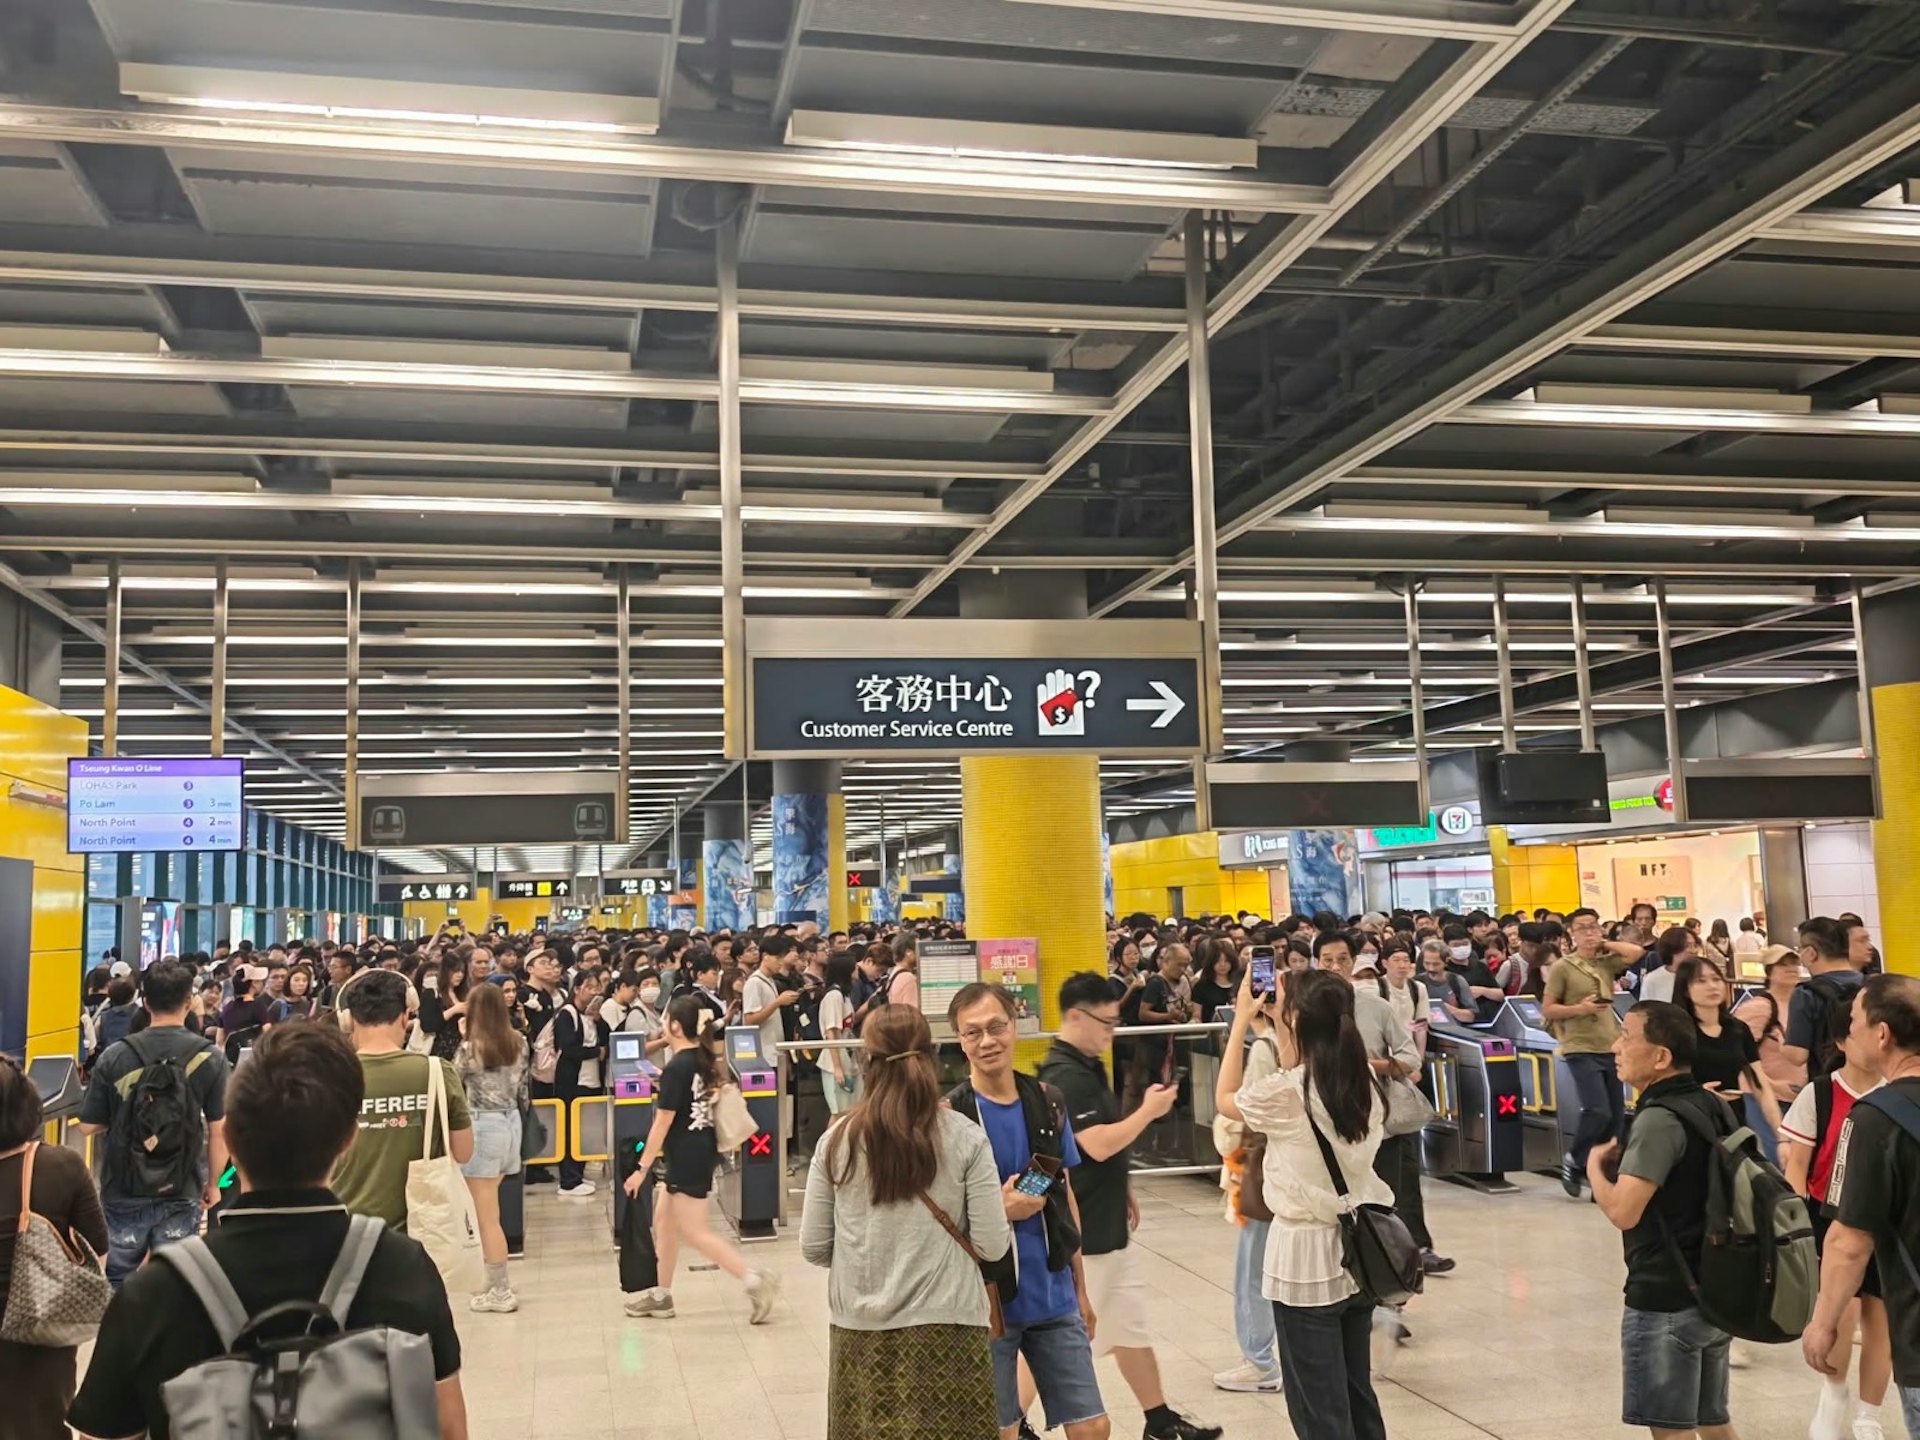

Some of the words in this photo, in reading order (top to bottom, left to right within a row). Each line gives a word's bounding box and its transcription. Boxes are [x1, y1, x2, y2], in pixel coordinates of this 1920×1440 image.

[855, 674, 1013, 713] 客務中心
[800, 720, 888, 738] Customer
[889, 720, 953, 738] Service
[956, 719, 1014, 738] Centre
[79, 764, 110, 774] Tseung
[111, 764, 135, 772] Kwan
[135, 764, 143, 772] O
[144, 764, 163, 772] Line
[79, 781, 114, 789] LOHAS
[116, 781, 137, 789] Park
[79, 800, 92, 808] Po
[94, 800, 116, 808] Lam
[209, 799, 216, 808] 3
[79, 818, 108, 827] North
[110, 818, 136, 827] Point
[209, 817, 216, 826] 2
[79, 836, 108, 845] North
[110, 836, 136, 845] Point
[208, 835, 216, 844] 4
[358, 1094, 428, 1115] FEREE
